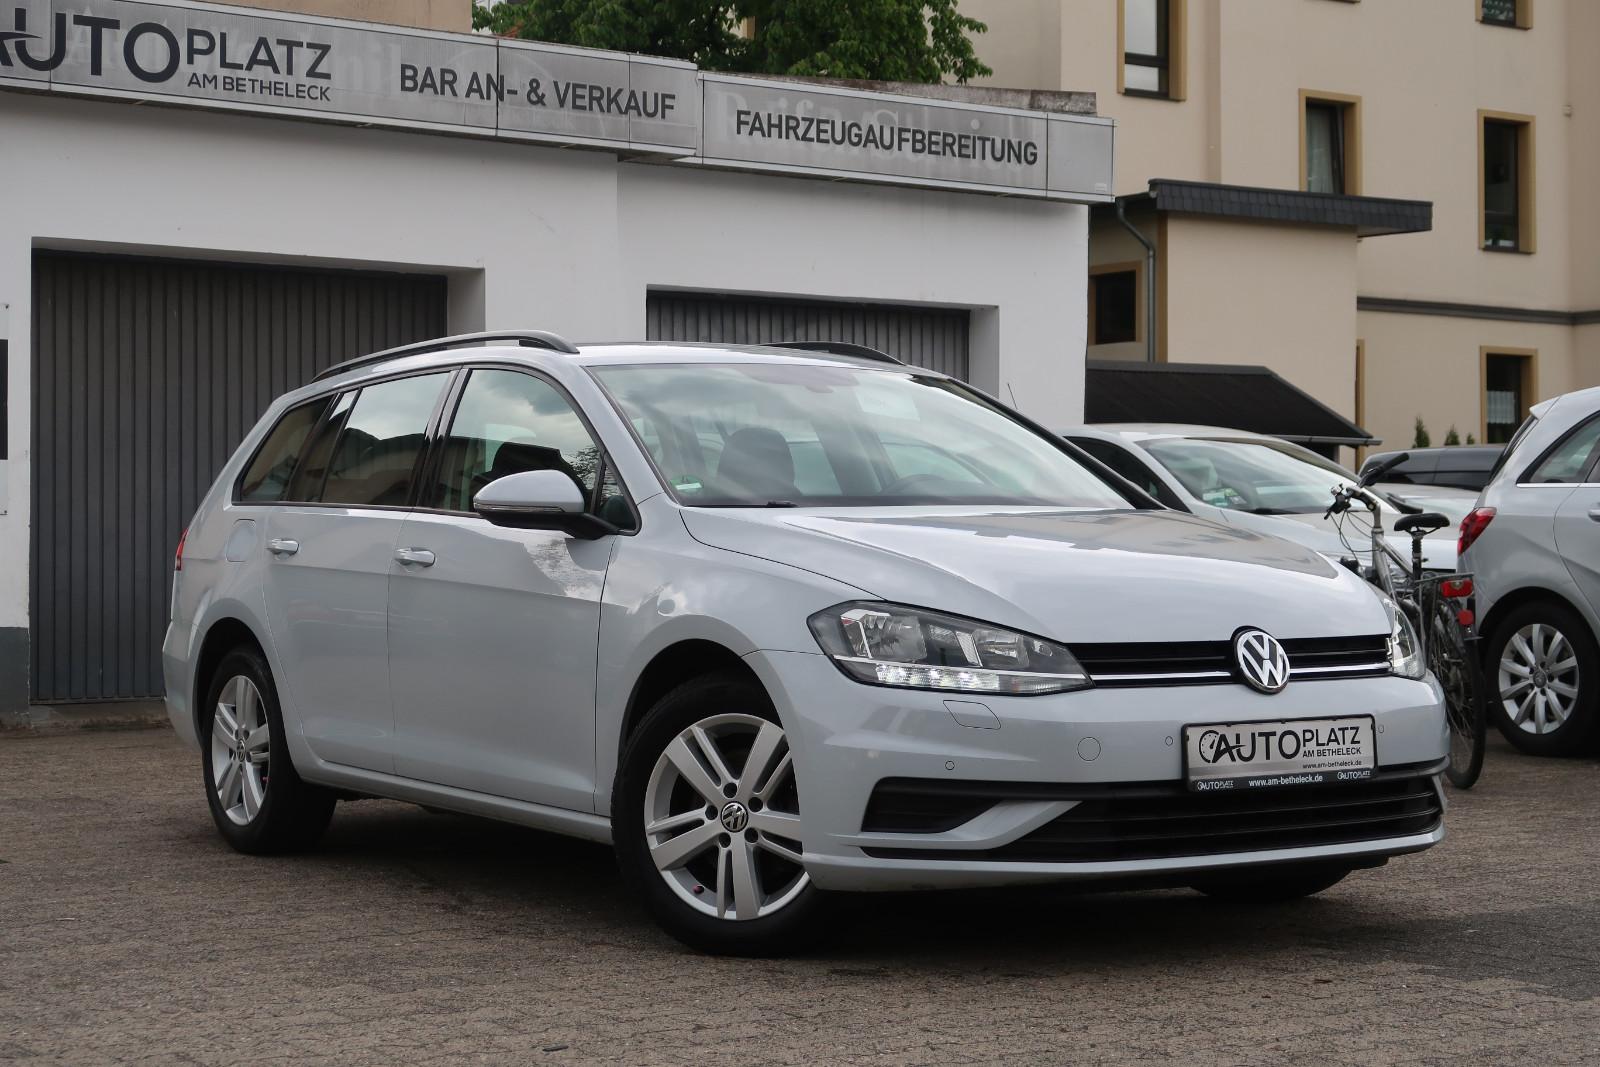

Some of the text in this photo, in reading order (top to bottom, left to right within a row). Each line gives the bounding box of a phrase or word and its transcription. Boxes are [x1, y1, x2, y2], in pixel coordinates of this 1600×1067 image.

[187, 72, 331, 102] AM BETHELECK
[399, 63, 677, 120] BAR AN- & VERKAUF
[735, 109, 1039, 166] FAHRZEUGAUFBEREITUNG
[1302, 747, 1362, 758] AM BETHELECK
[1248, 774, 1323, 787] www.am-betheleck.de
